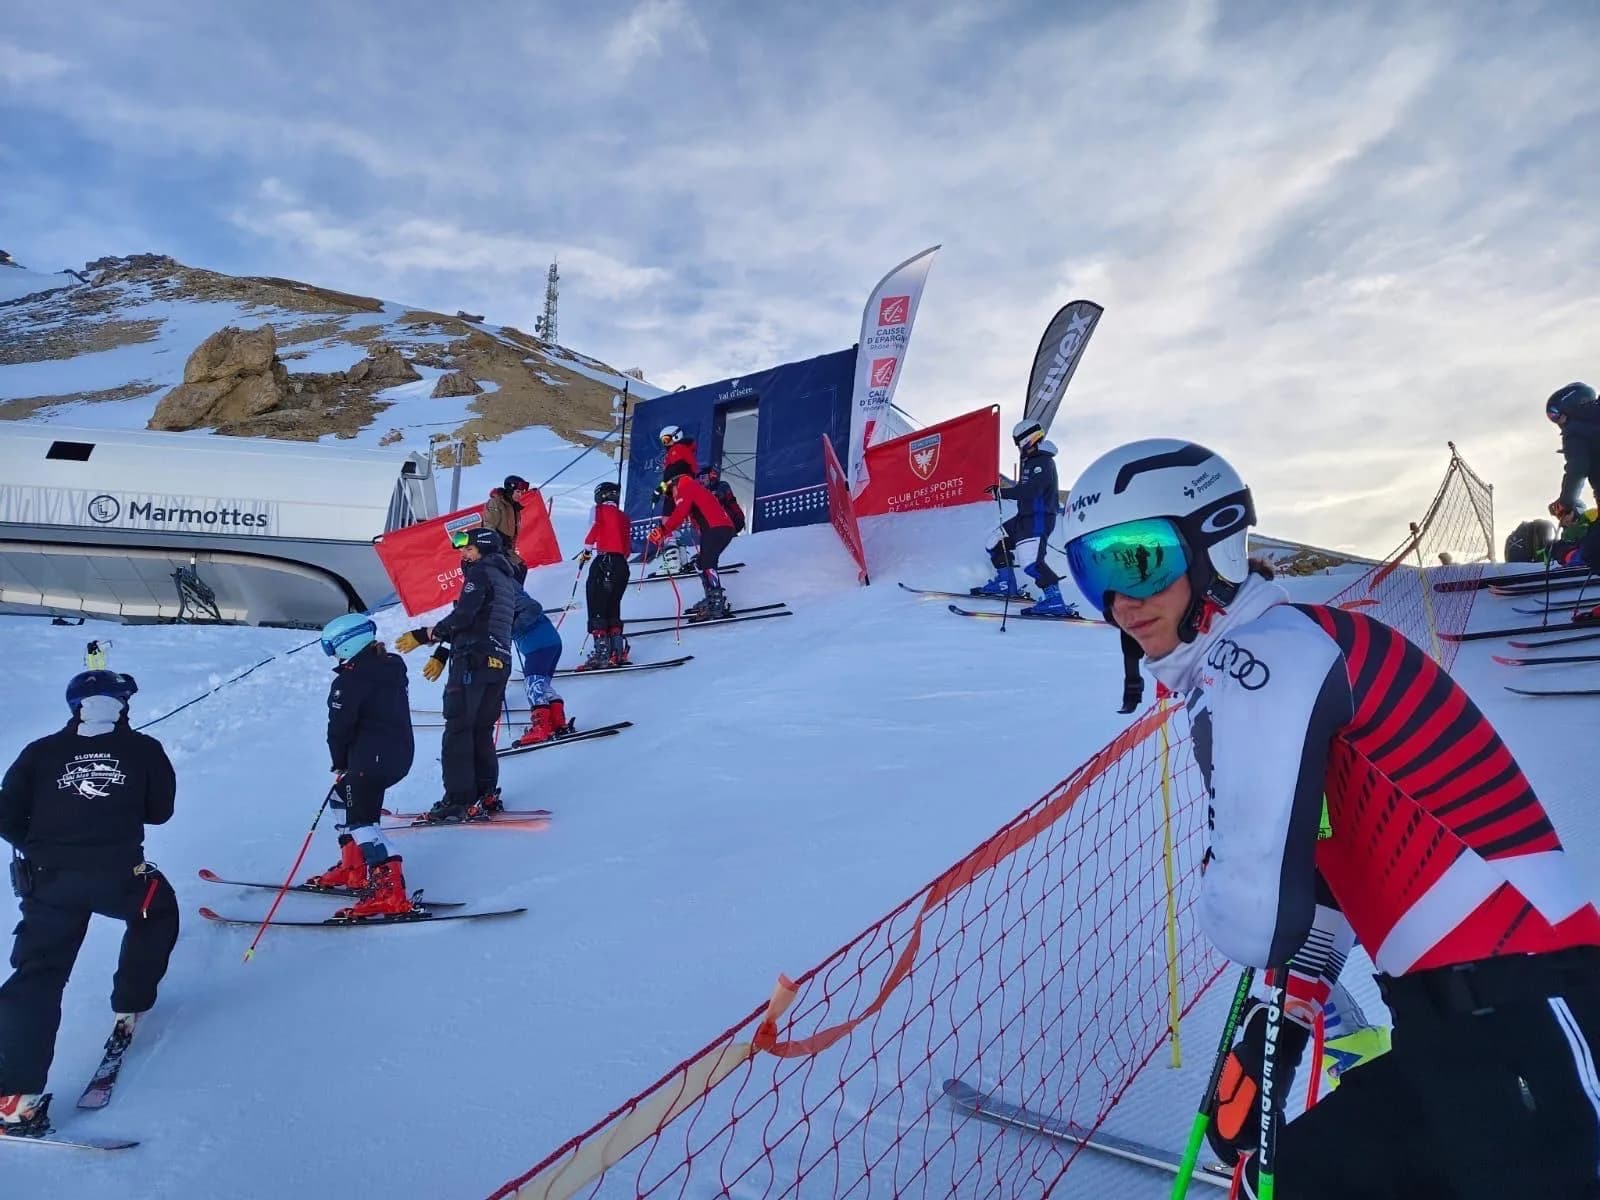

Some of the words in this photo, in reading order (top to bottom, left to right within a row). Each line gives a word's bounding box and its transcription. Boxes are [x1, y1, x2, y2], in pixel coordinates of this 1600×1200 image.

[876, 327, 905, 336] CAISSE
[1037, 312, 1092, 401] uvex
[1191, 472, 1209, 487] Sweet
[1197, 472, 1223, 493] Protection
[887, 492, 911, 505] CLUB
[913, 488, 928, 499] DES
[929, 477, 964, 493] SPORTS
[1071, 491, 1101, 513] vkw
[129, 501, 267, 527] Marmottes
[437, 567, 464, 583] CLUB
[441, 580, 455, 591] DE
[74, 753, 111, 761] SLOVAKIA
[1259, 985, 1283, 1165] KOMPERDELL
